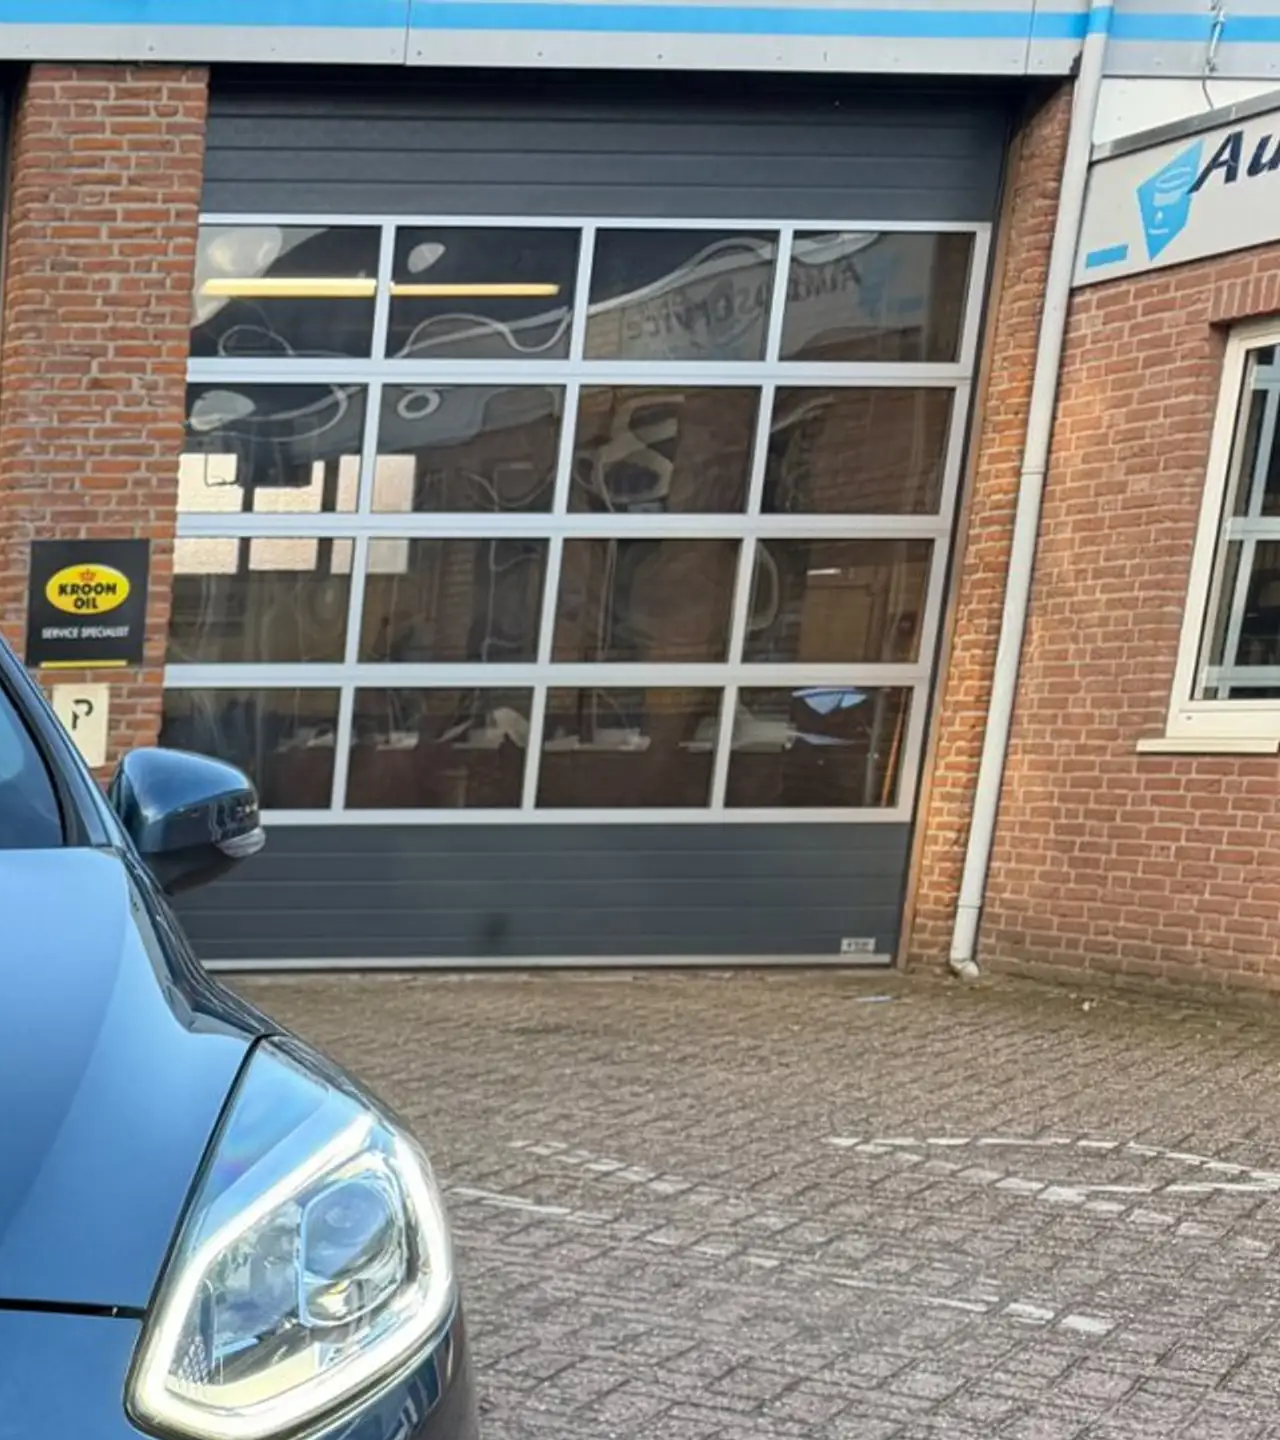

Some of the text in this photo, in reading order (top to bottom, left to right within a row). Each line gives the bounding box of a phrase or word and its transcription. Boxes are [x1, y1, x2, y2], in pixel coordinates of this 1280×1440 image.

[58, 583, 117, 597] KROON
[74, 597, 98, 609] OIL
[42, 626, 78, 639] SERVICE
